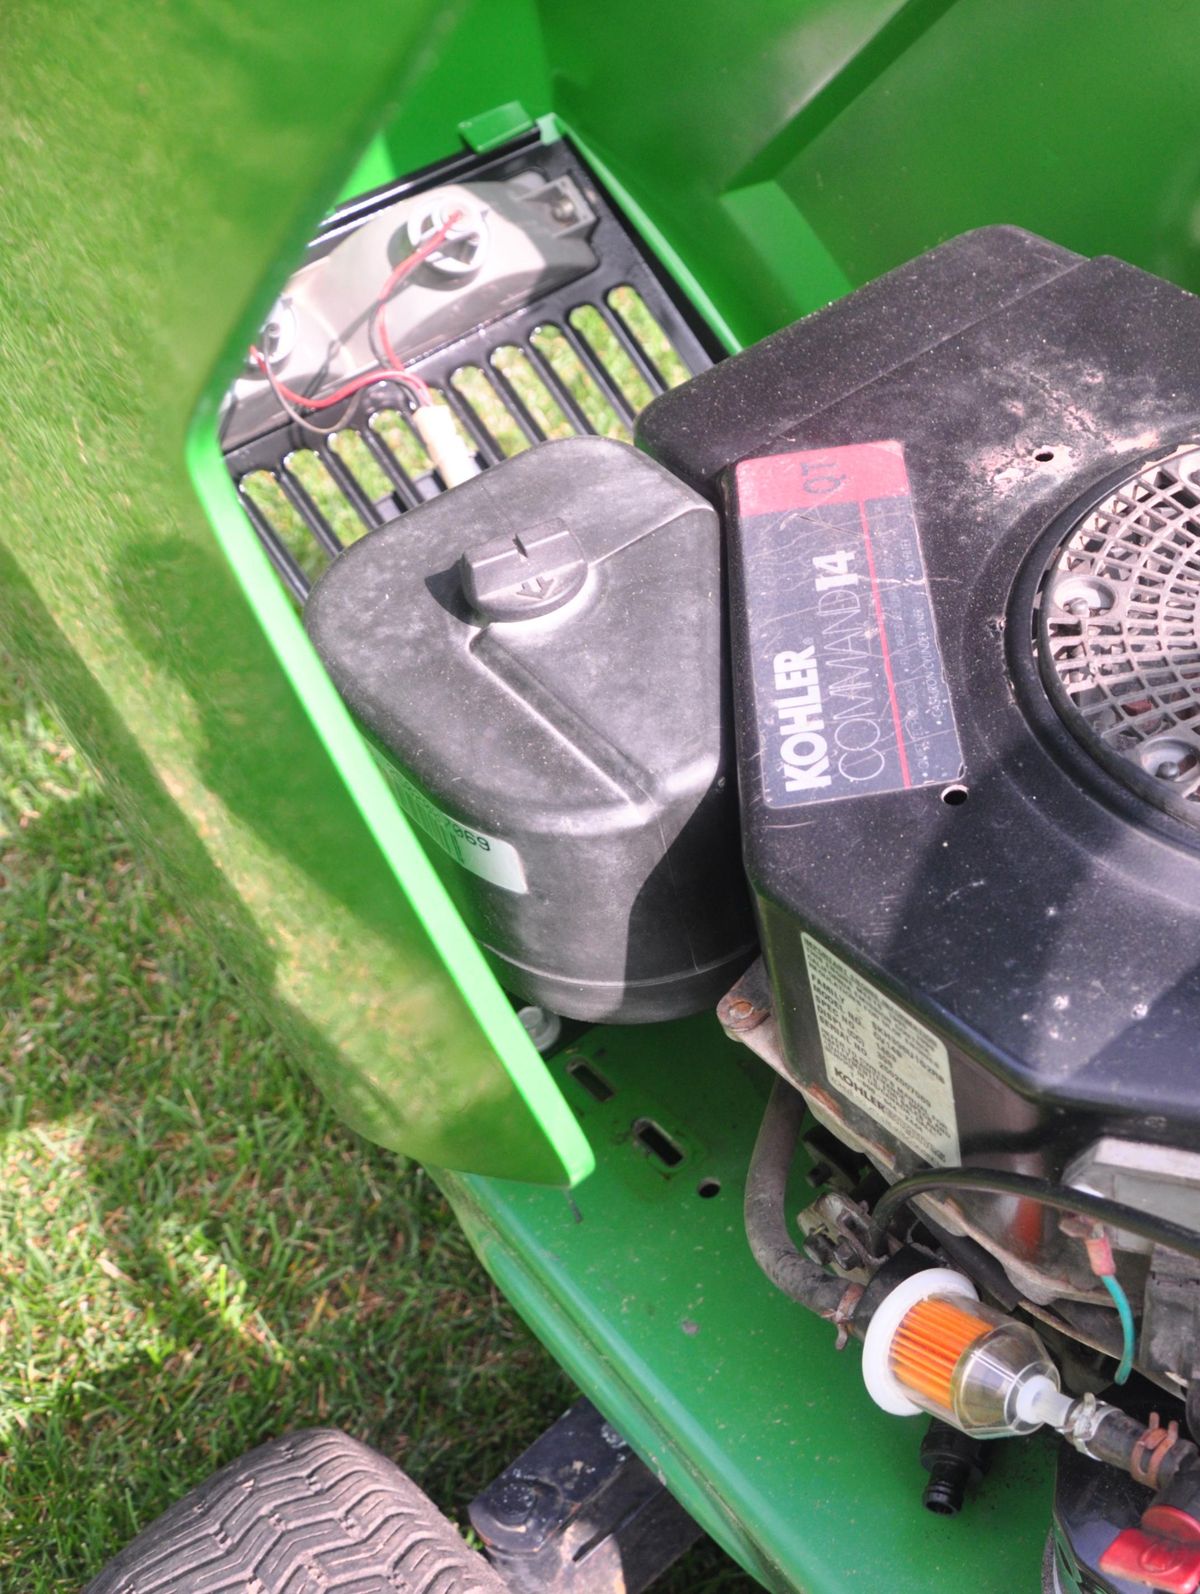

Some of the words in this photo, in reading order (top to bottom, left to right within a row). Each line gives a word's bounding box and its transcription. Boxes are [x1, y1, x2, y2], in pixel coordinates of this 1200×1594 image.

[800, 462, 847, 494] QT
[812, 550, 859, 592] 14
[818, 589, 885, 781] COMMAND
[773, 644, 832, 792] KOHLER
[810, 972, 844, 1006] FAMILY
[812, 982, 845, 1015] MODEL
[815, 993, 838, 1018] SPEC
[818, 1014, 851, 1046] SERIAL
[833, 1065, 885, 1113] KOHLER
